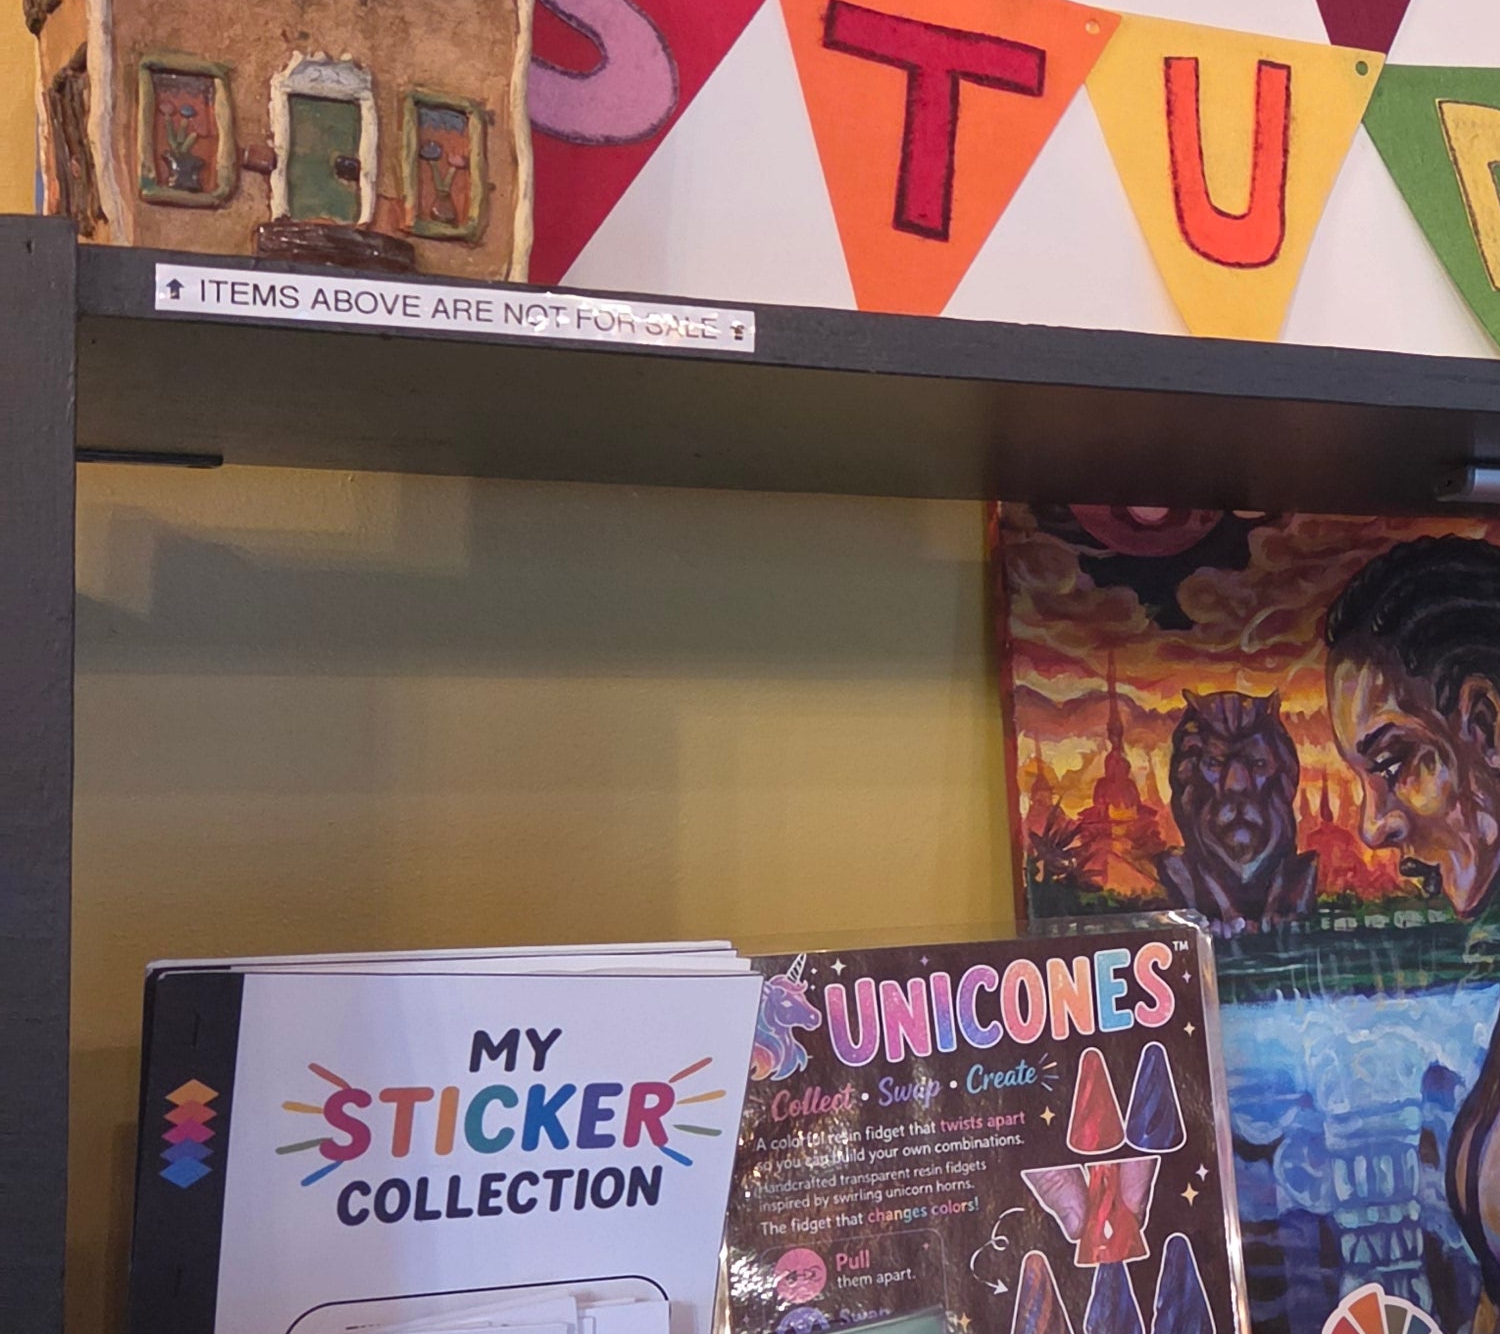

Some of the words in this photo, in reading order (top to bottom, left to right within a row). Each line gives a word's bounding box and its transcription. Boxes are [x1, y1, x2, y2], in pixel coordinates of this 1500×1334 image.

[200, 277, 299, 309] ITEMS
[311, 288, 420, 319] ABOVE
[431, 298, 493, 324] ARE
[503, 303, 566, 330] NOT
[576, 309, 636, 334] FOR
[645, 316, 718, 340] SALE
[469, 1027, 563, 1073] MY
[772, 1086, 853, 1122] Collect
[878, 1074, 941, 1109] Swap
[966, 1060, 1038, 1095] Create
[319, 1081, 676, 1163] STICKER
[756, 1137, 767, 1151] A
[865, 1123, 905, 1142] fidget
[909, 1121, 936, 1135] that
[940, 1118, 983, 1132] twists
[987, 1113, 1026, 1129] apart
[776, 1158, 800, 1173] you
[869, 1148, 899, 1164] your
[902, 1145, 931, 1157] own
[934, 1133, 1024, 1154] combinations.
[840, 1168, 910, 1190] transparent
[914, 1163, 942, 1178] resin
[946, 1159, 986, 1177] fidgets
[336, 1165, 663, 1226] COLLECTION
[759, 1197, 810, 1215] inspired
[814, 1195, 830, 1210] by
[833, 1187, 883, 1205] swirling
[886, 1183, 932, 1198] unicorn
[936, 1178, 974, 1193] horns.
[760, 1221, 787, 1236] The
[791, 1217, 832, 1235] fidget
[836, 1213, 864, 1226] that
[868, 1206, 928, 1225] changes
[931, 1197, 979, 1216] colors!
[836, 1249, 870, 1271] Pull
[837, 1274, 872, 1288] them
[876, 1268, 916, 1287] apart.
